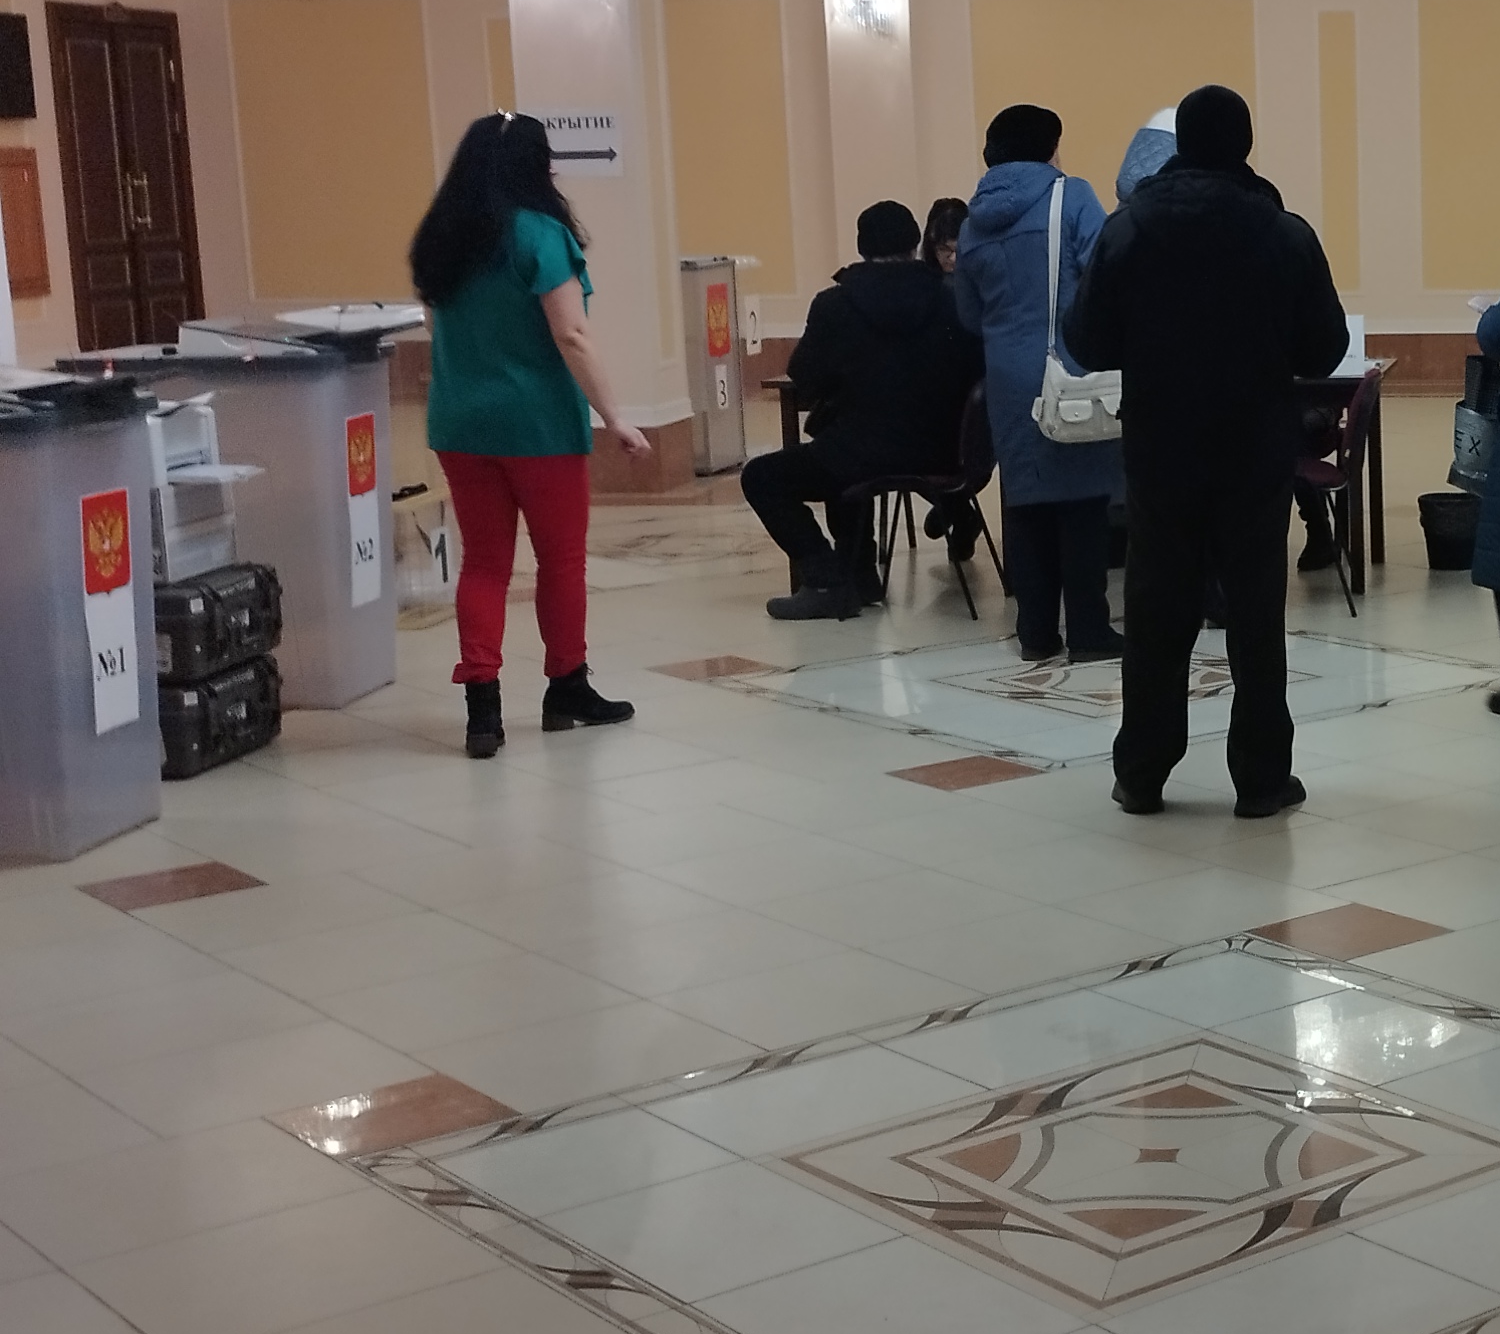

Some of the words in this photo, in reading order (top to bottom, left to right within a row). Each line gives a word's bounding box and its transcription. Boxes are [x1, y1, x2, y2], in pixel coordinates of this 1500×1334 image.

[541, 116, 616, 129] КРЫТИЕ
[749, 310, 758, 345] 2
[719, 379, 727, 406] 3
[434, 533, 449, 584] 1
[95, 647, 126, 682] №1
